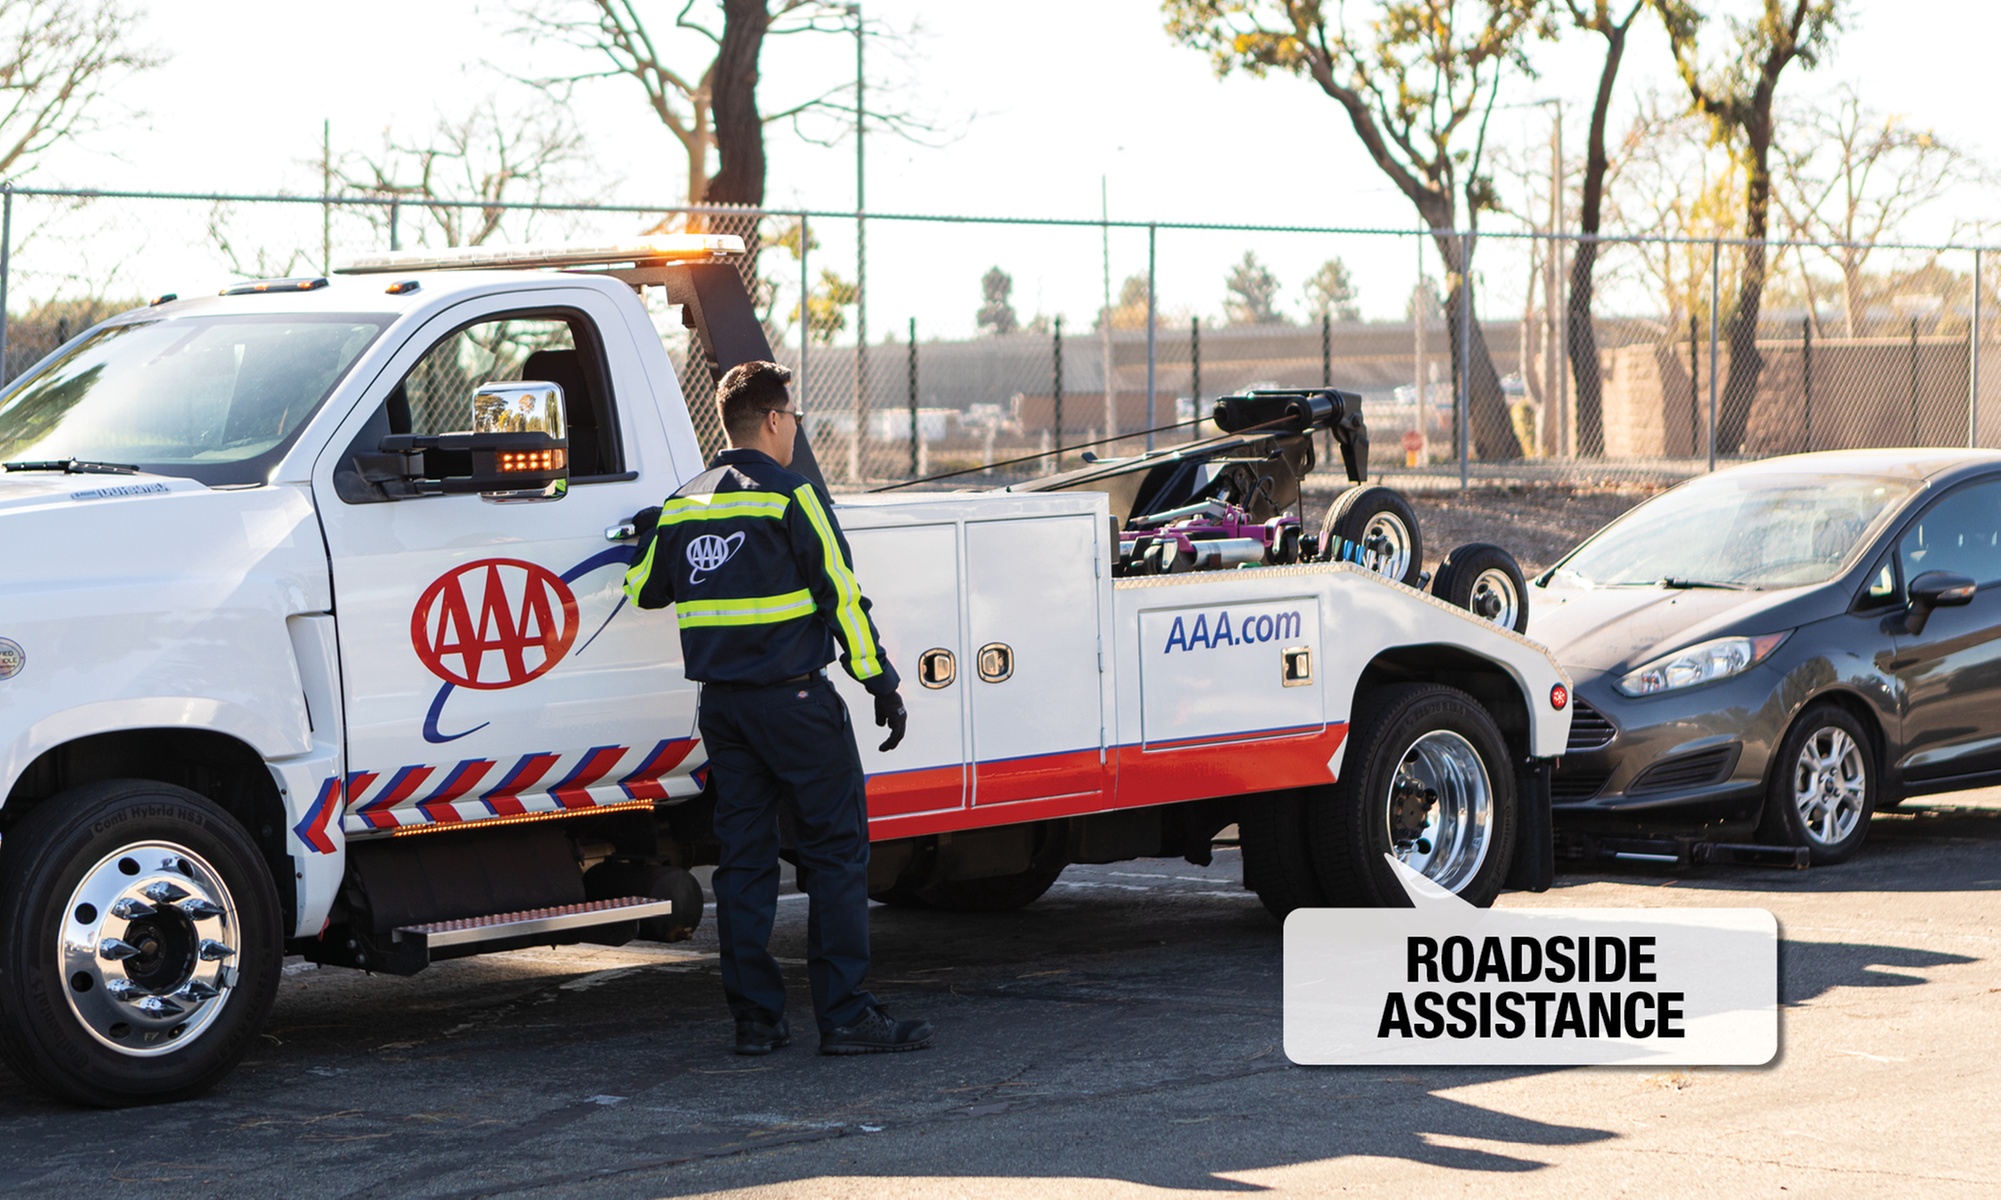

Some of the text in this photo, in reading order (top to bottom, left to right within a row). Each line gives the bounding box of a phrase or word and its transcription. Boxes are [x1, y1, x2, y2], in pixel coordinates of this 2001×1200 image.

[686, 534, 729, 571] AAA
[411, 558, 579, 690] AAA
[1164, 611, 1301, 654] AAA.com
[94, 804, 204, 834] Conti Hybrid HS3
